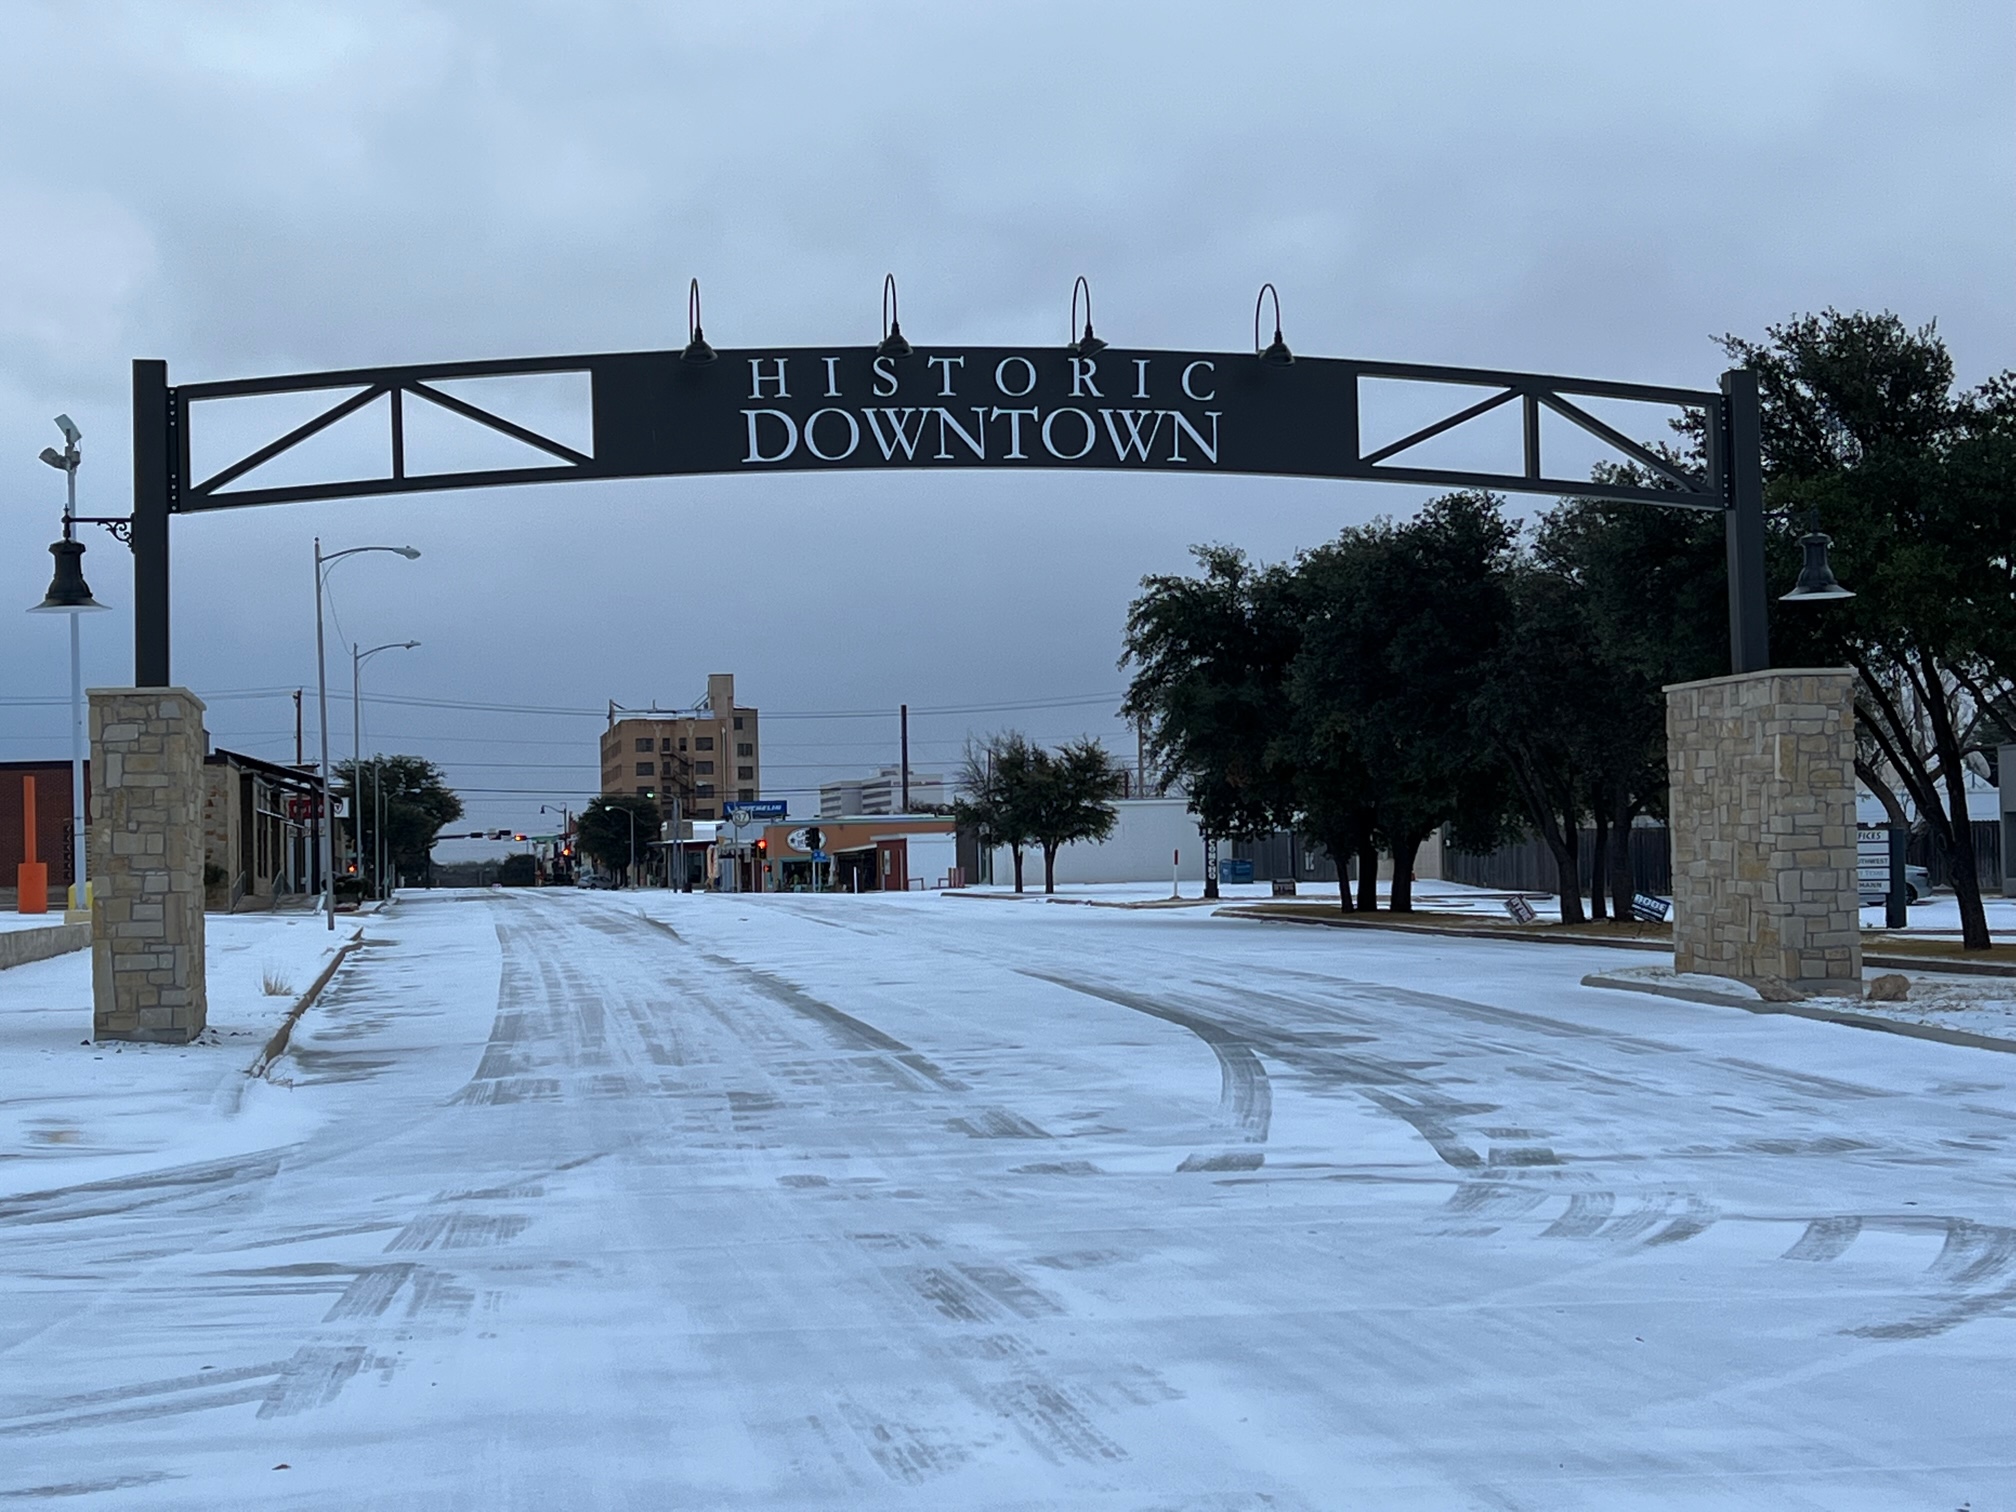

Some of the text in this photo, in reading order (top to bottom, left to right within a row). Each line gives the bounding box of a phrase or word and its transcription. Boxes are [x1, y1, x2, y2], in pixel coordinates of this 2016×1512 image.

[747, 356, 1216, 400] HISTORIC
[740, 406, 1222, 464] DOWNTOWN
[1858, 832, 1881, 840] FICES
